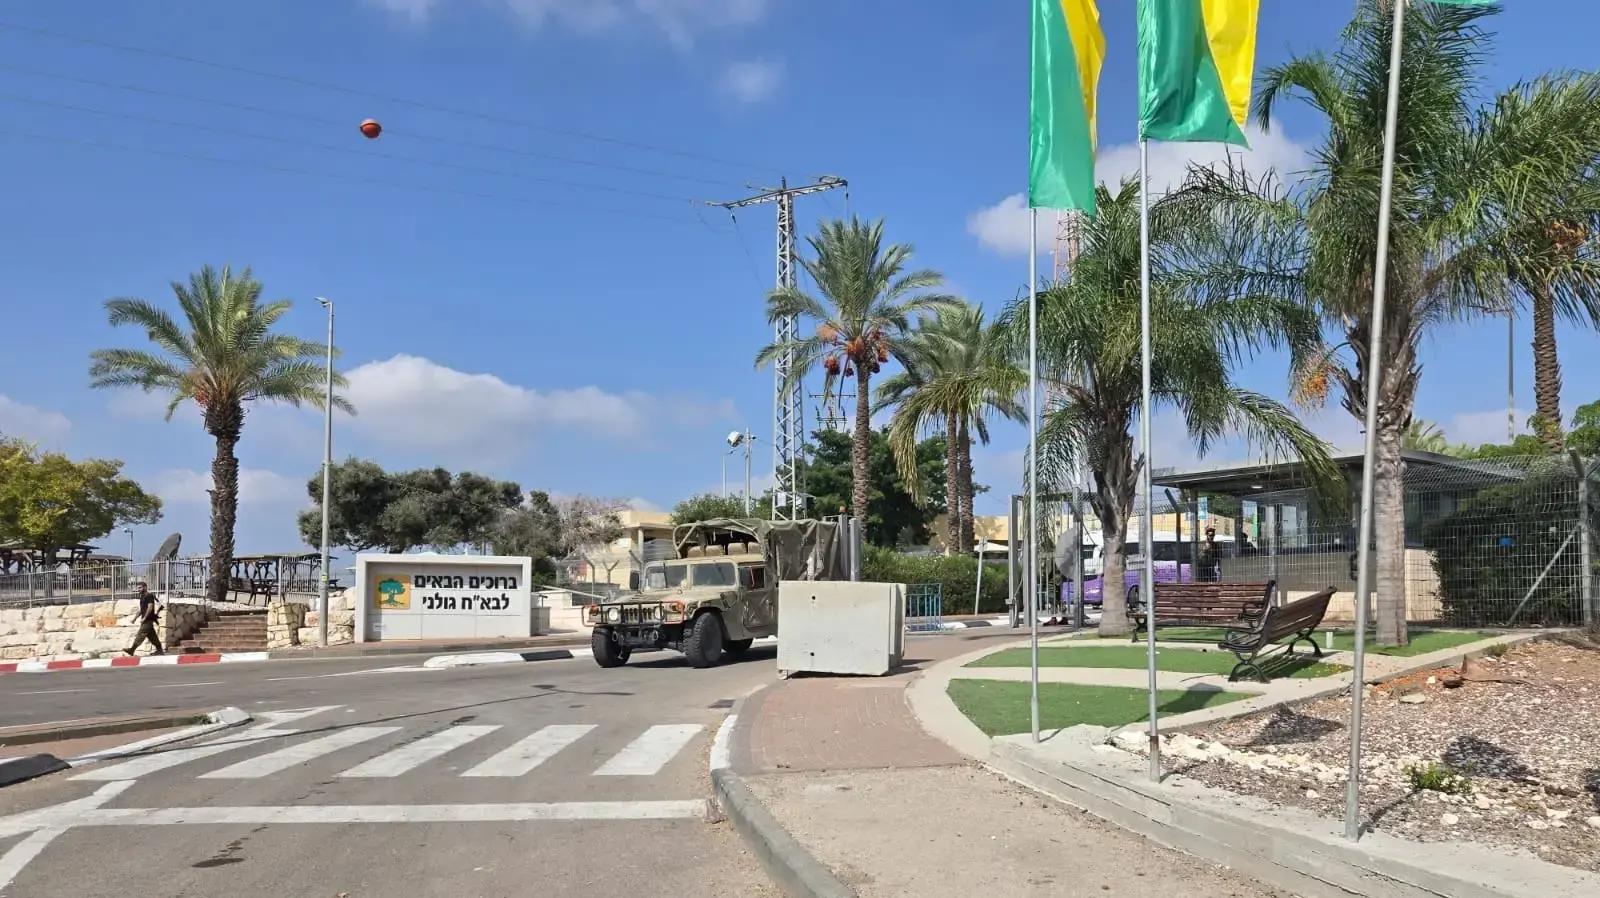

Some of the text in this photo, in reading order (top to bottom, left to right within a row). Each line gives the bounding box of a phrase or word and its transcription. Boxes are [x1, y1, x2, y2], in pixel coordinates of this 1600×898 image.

[414, 574, 518, 590] ברוכים הבאים
[422, 592, 456, 610] גולני
